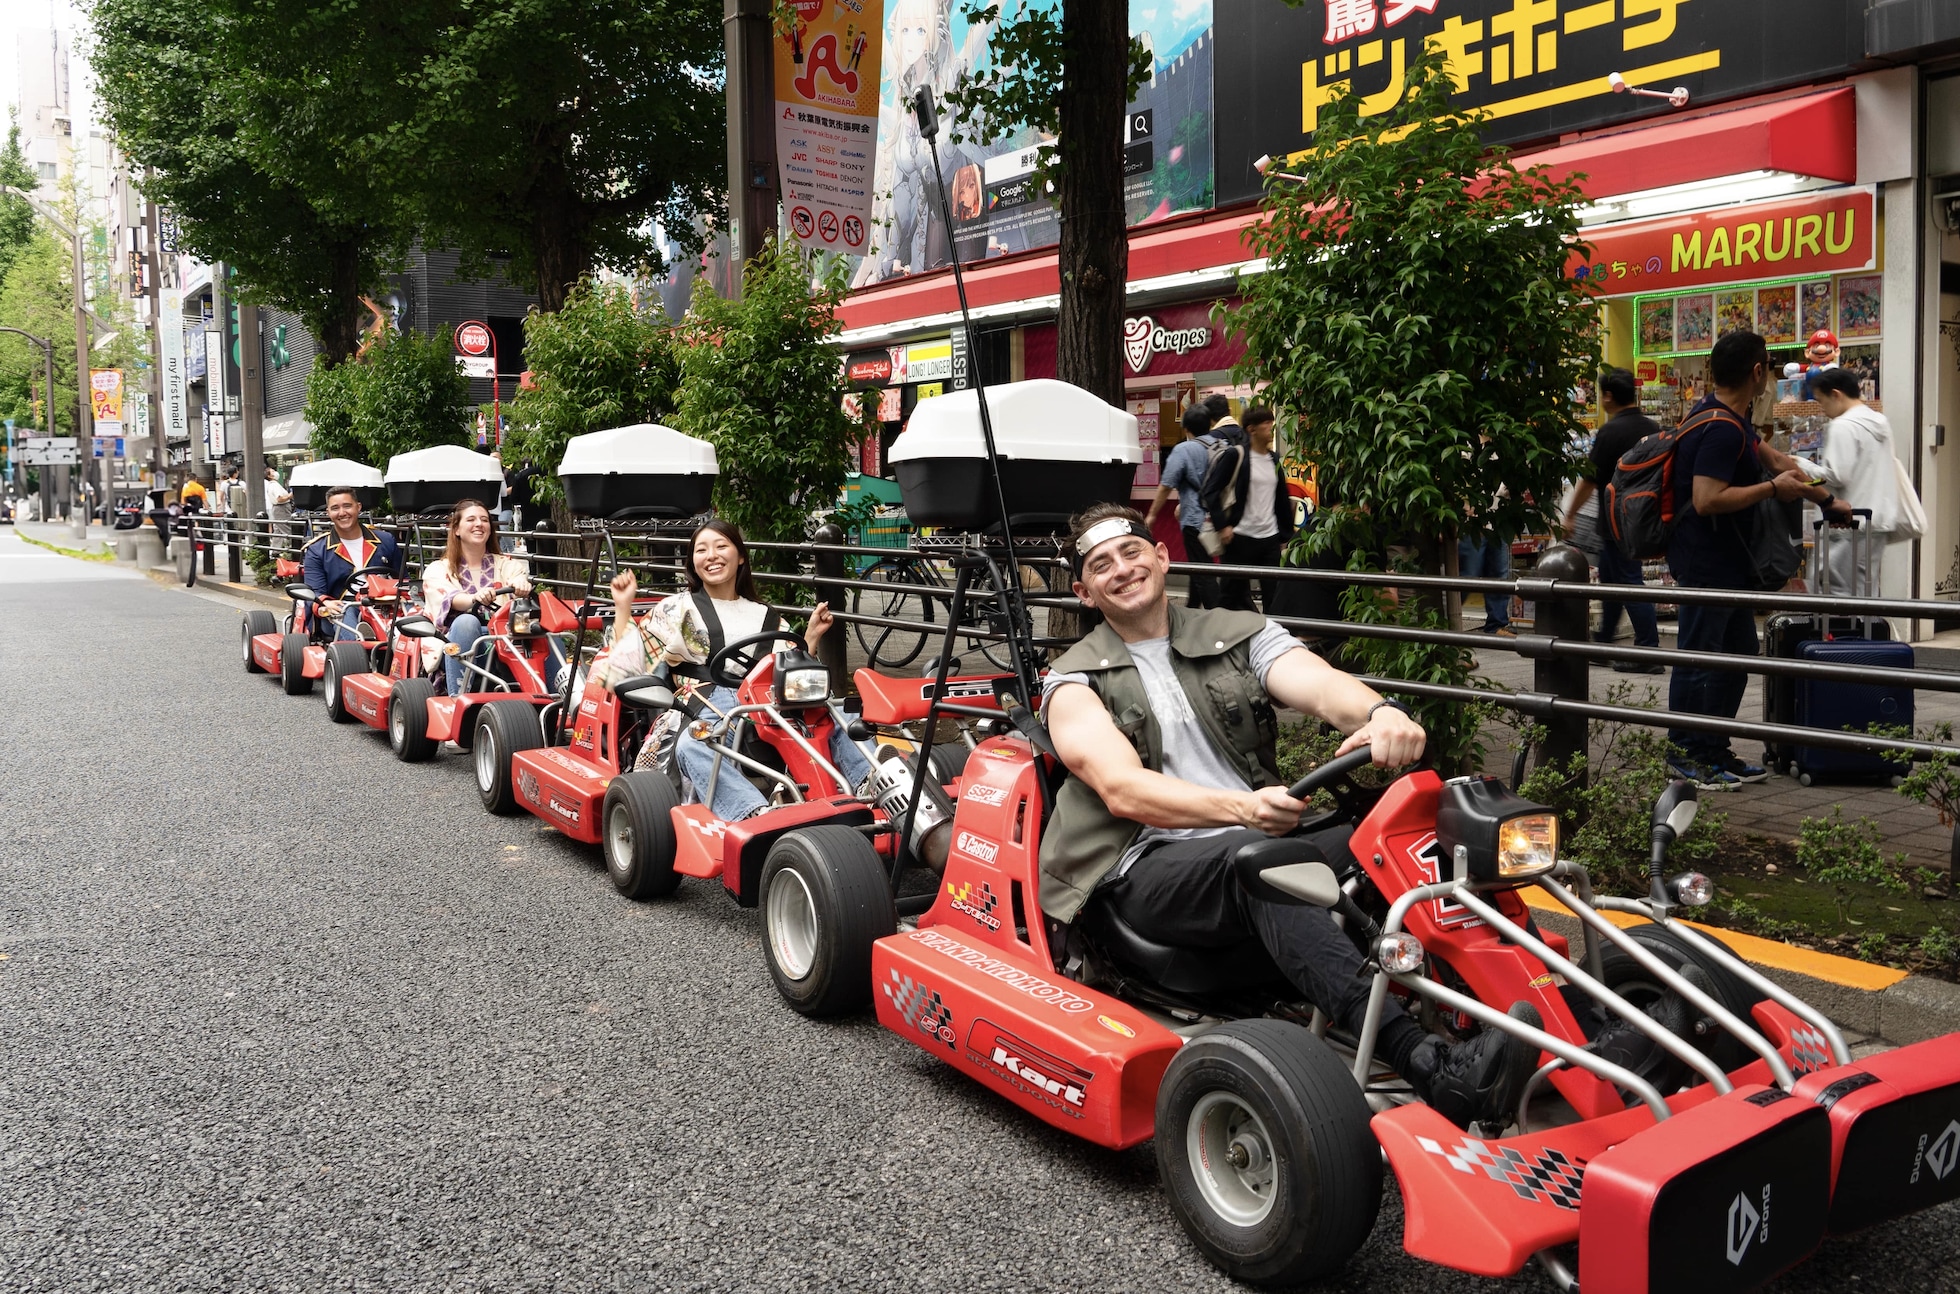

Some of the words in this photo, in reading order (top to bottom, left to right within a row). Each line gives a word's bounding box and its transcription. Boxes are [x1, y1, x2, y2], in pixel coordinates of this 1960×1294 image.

[818, 94, 856, 107] AKIHABARA
[798, 112, 870, 134] 秋葉原電気街振興会
[790, 139, 807, 147] ASK
[802, 128, 848, 143] www.akiba.or.jp
[817, 144, 836, 155] ASSY
[791, 152, 807, 161] JVC
[815, 157, 838, 166] SHARP
[840, 162, 866, 171] SONY
[791, 166, 813, 174] DAIKIN
[815, 169, 838, 179] TOSHIBA
[840, 174, 863, 184] DENON
[787, 178, 814, 188] Panasonic
[816, 183, 838, 192] HITACHI
[1000, 184, 1022, 197] Google
[1574, 256, 1663, 281] おもちゃの
[1670, 207, 1856, 274] MARURU
[463, 334, 487, 346] 消火栓
[1152, 328, 1206, 352] Crepes
[908, 363, 926, 378] LONG!
[927, 359, 951, 376] LONGER
[550, 799, 579, 822] Kart
[965, 836, 998, 861] Castrol
[909, 930, 1094, 1013] STANDARDMOTO
[920, 1014, 956, 1043] 50
[965, 1053, 1086, 1119] streetpower
[990, 1046, 1086, 1107] Kart
